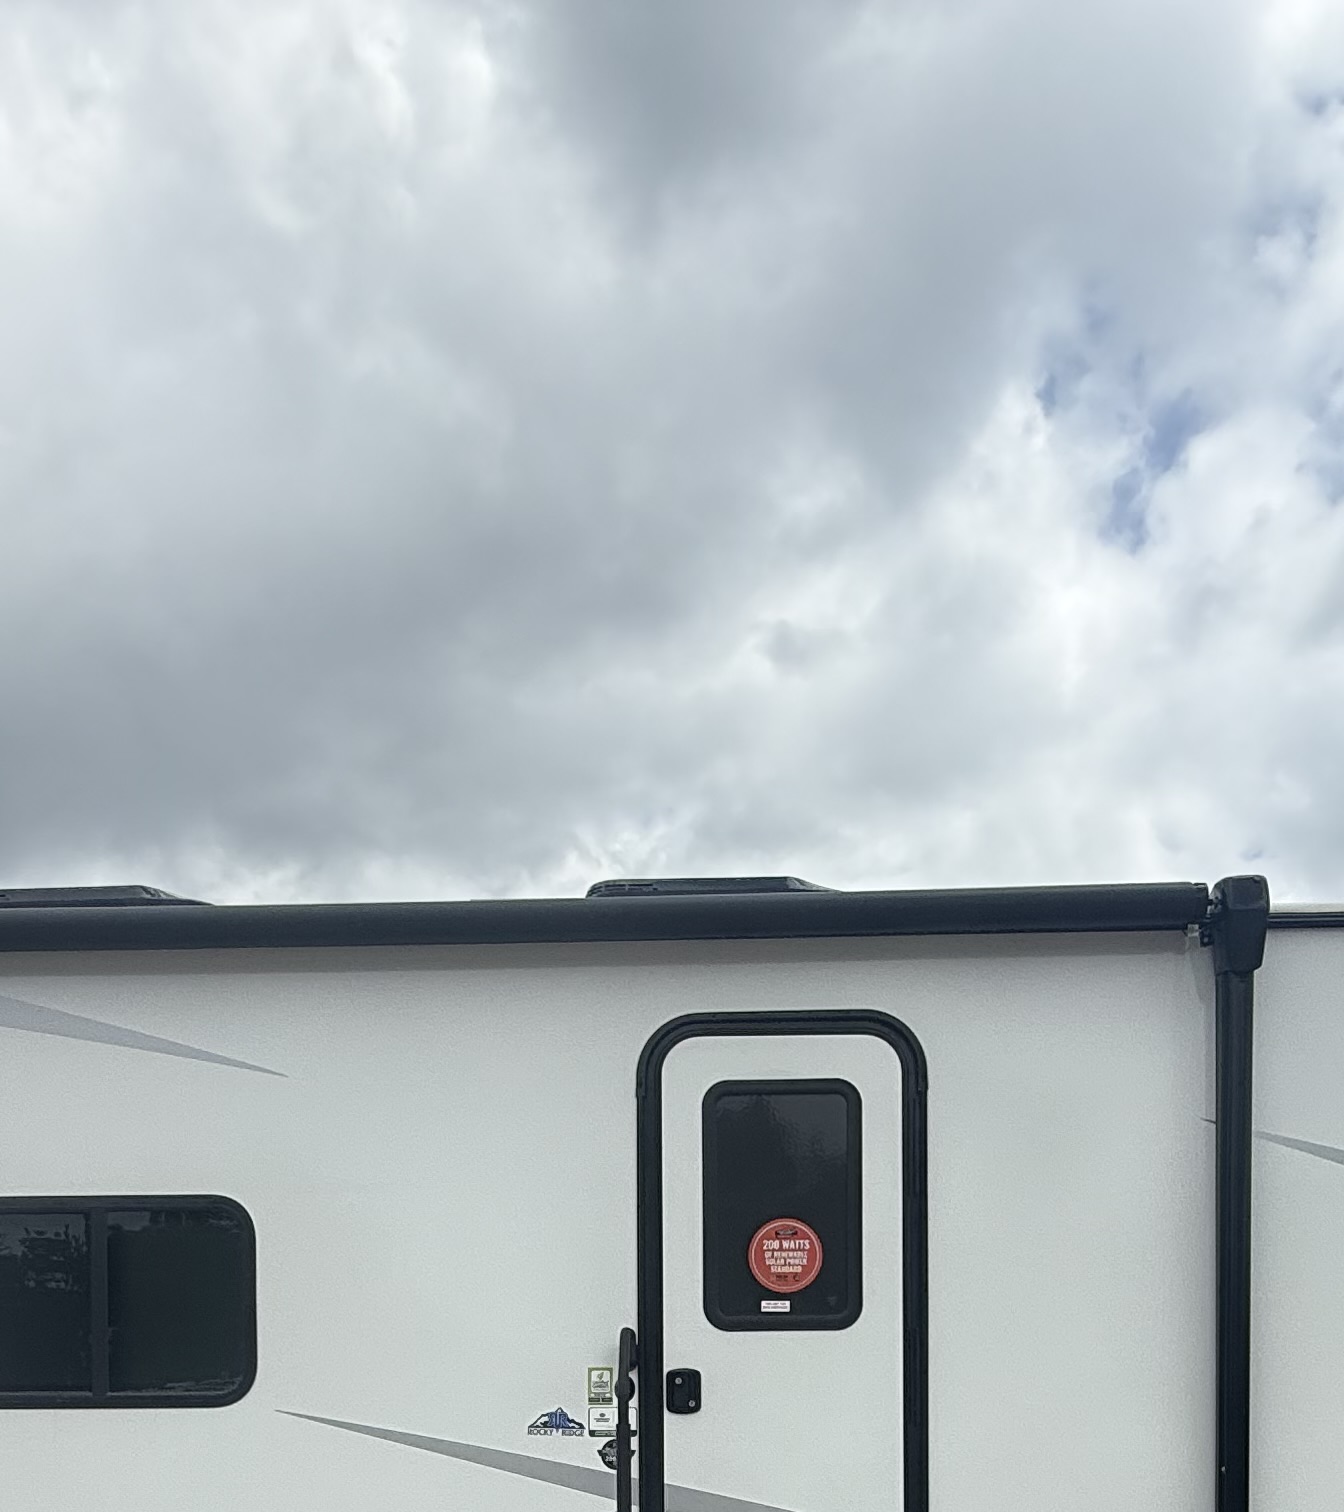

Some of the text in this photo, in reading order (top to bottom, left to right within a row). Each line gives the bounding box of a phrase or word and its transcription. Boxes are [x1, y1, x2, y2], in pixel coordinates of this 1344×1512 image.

[763, 1239, 810, 1250] 200 WATTS
[770, 1265, 803, 1273] STANDARD
[527, 1428, 554, 1436] ROCKY
[561, 1429, 585, 1437] RIDGE
